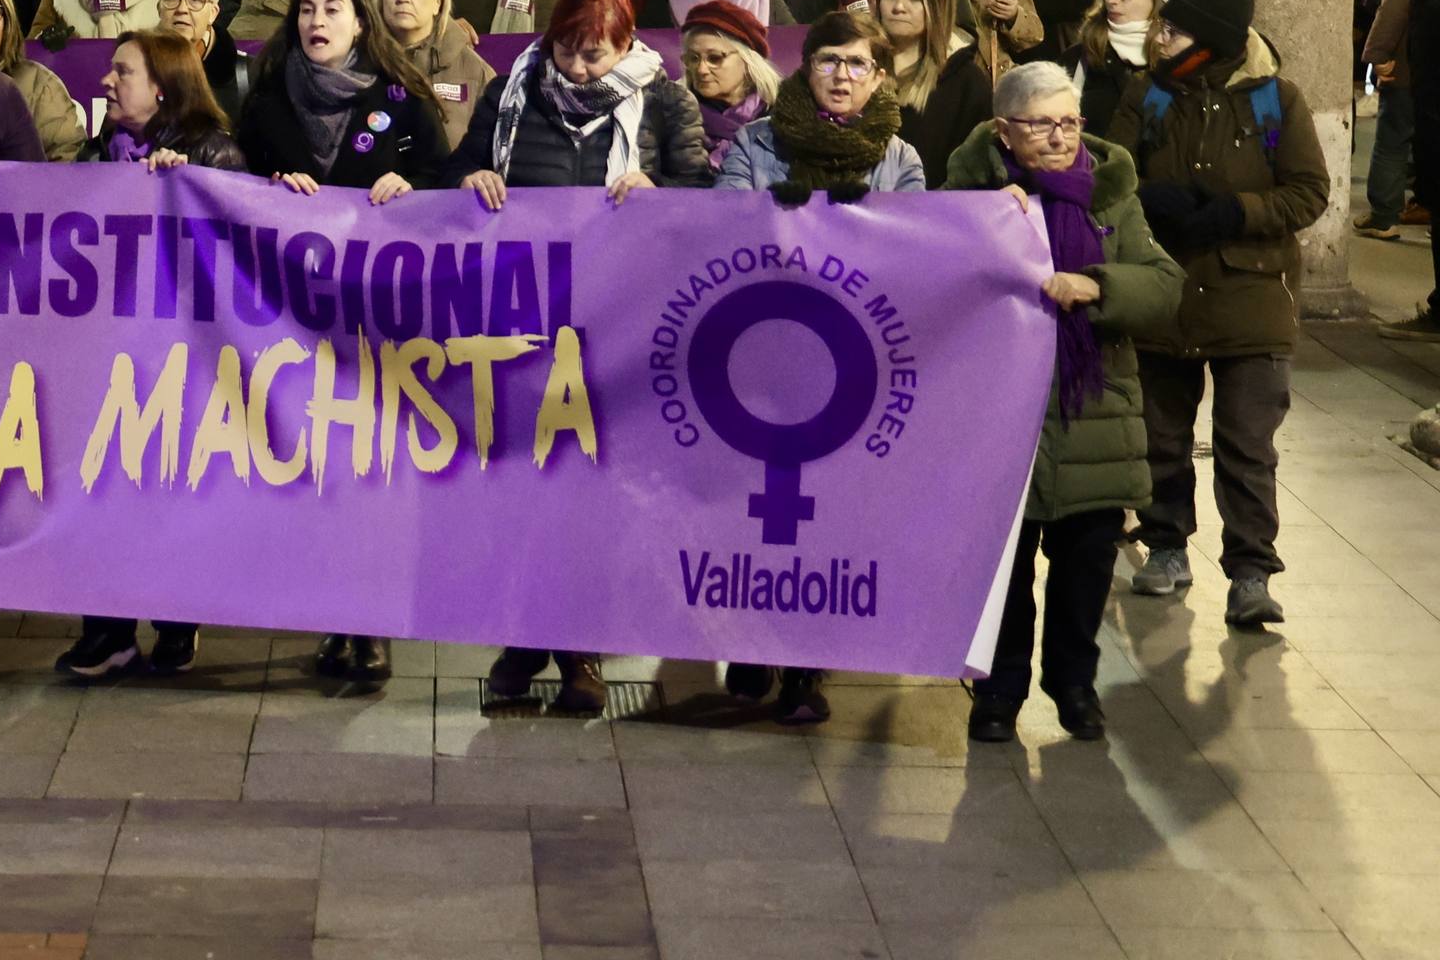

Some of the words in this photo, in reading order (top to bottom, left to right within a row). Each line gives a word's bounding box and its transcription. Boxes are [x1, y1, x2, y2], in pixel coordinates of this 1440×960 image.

[80, 324, 597, 495] MACHISTA
[651, 244, 808, 448] COORDINADORA
[819, 253, 870, 297] DE
[865, 293, 918, 459] MUJERES
[679, 550, 877, 617] Valladolid
